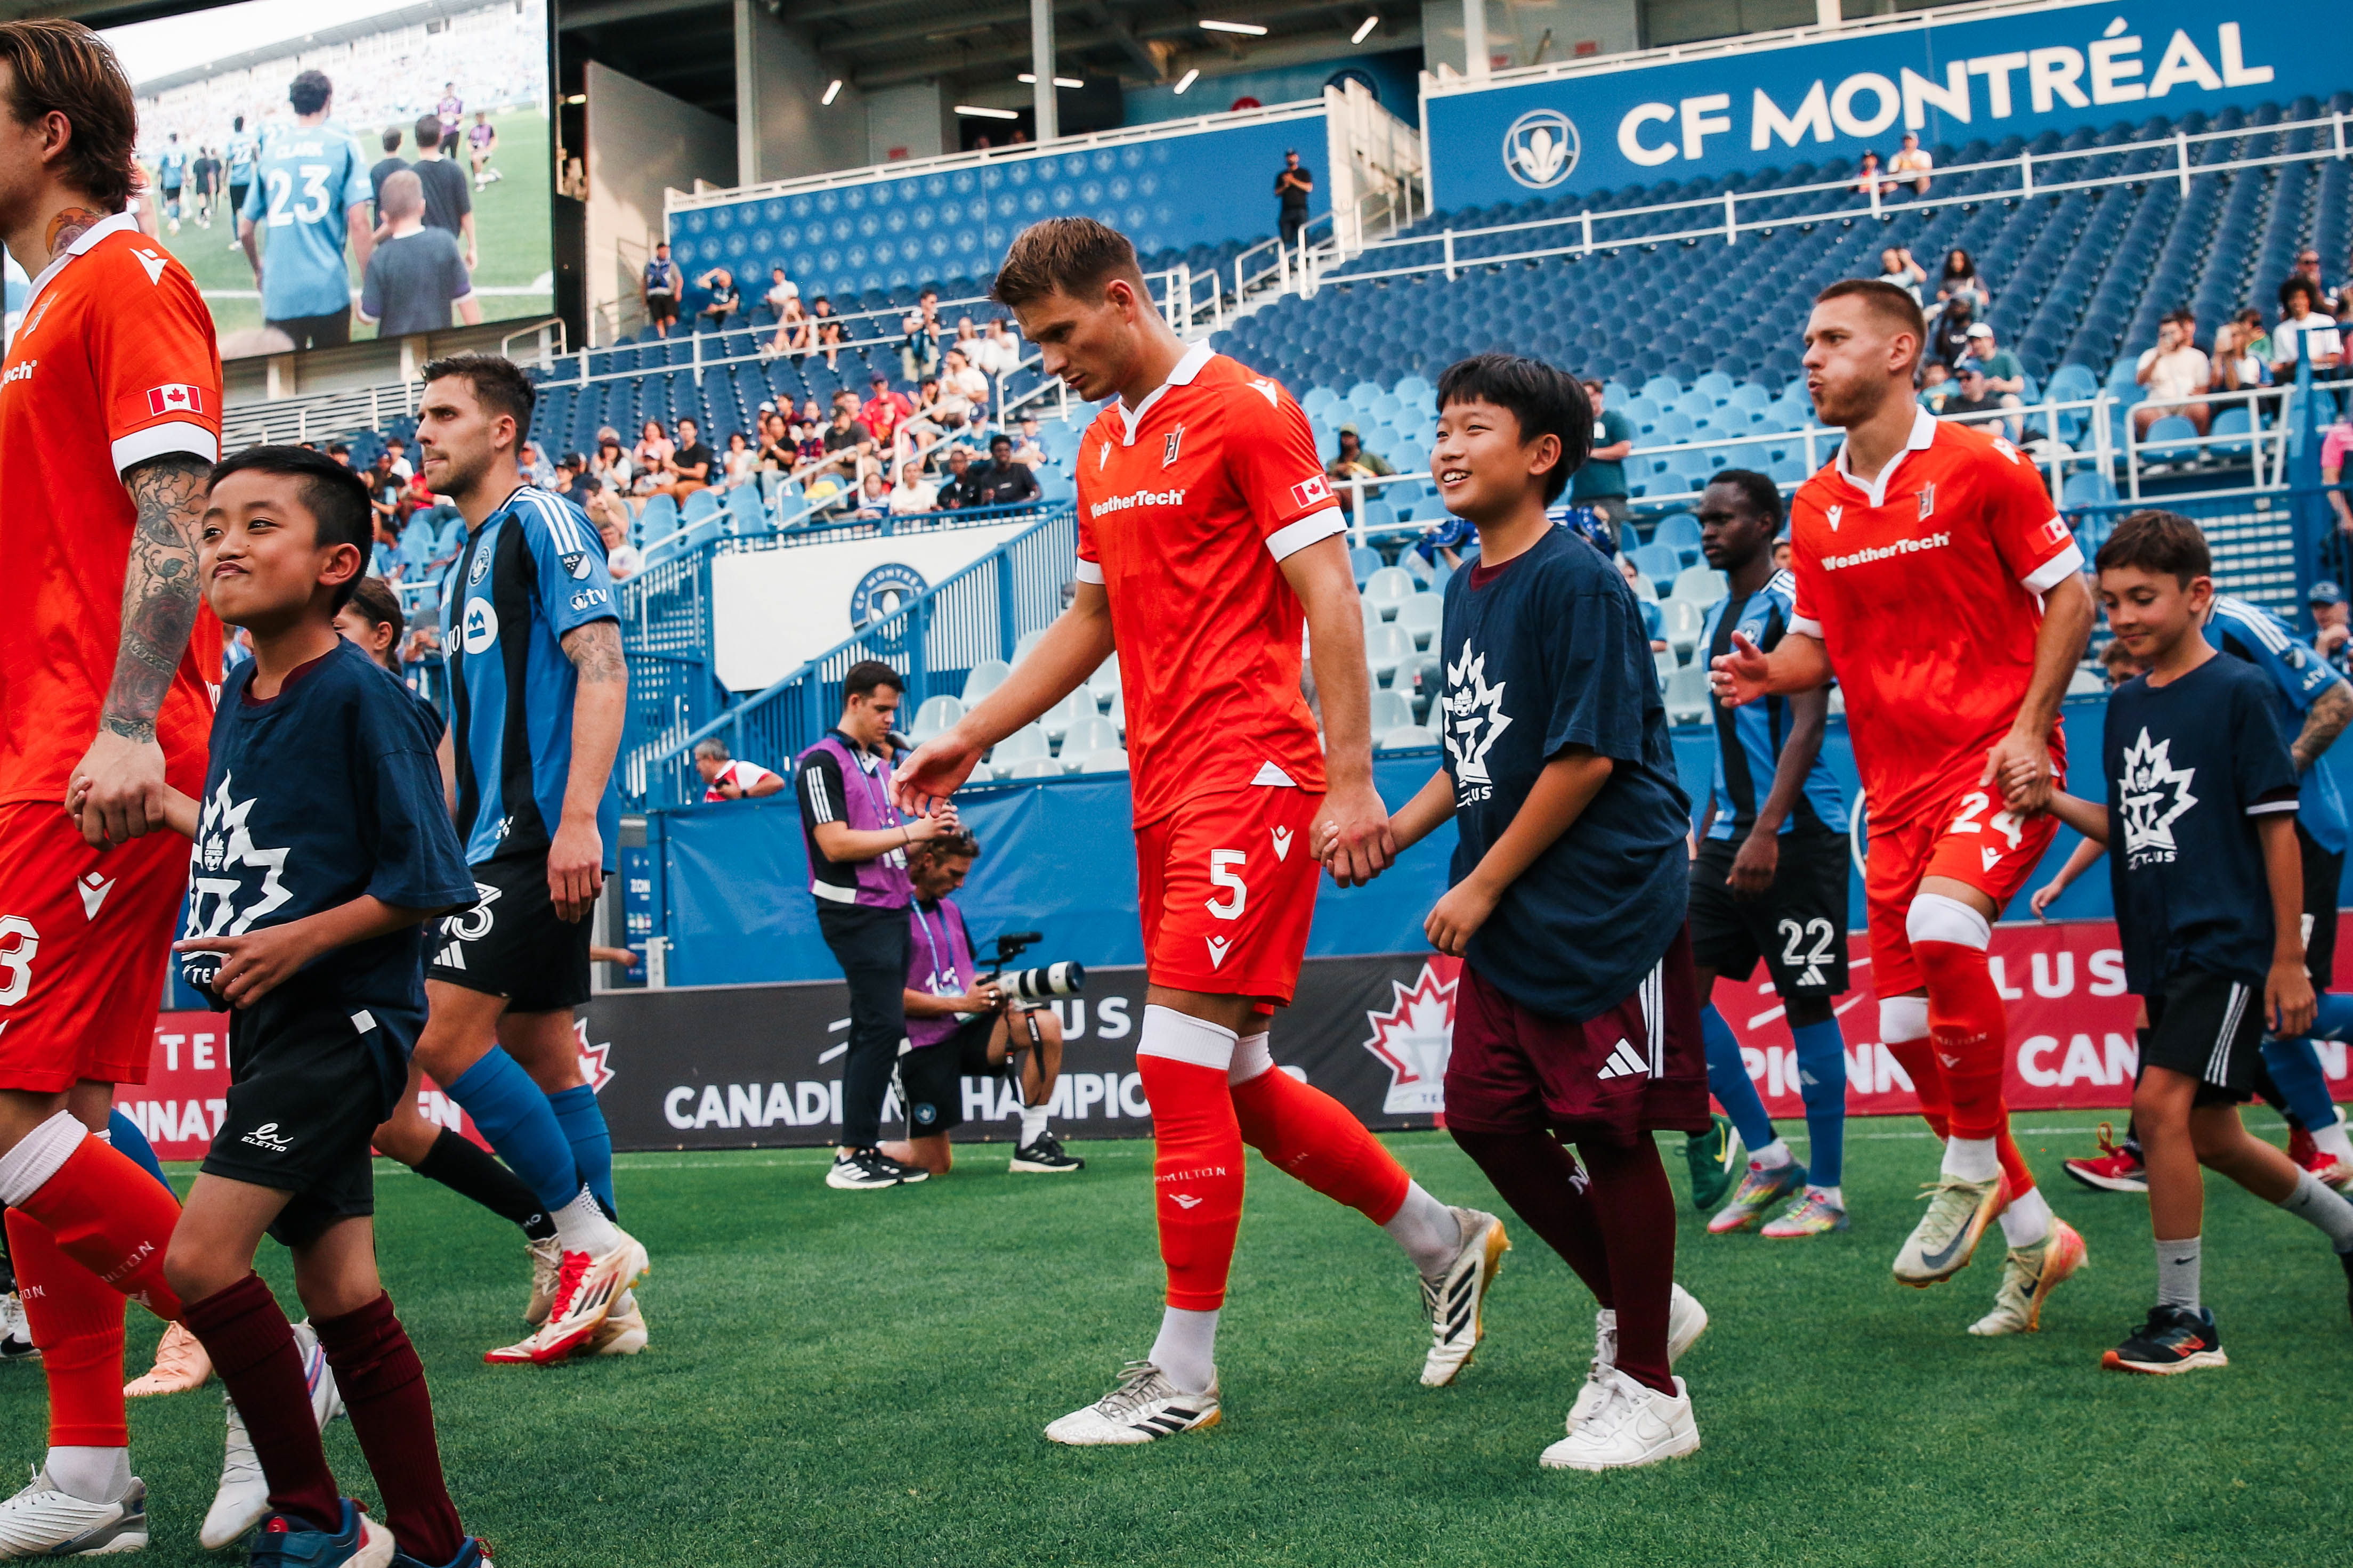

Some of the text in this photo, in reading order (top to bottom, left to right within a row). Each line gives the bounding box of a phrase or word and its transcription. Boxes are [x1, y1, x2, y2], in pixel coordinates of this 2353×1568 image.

[1617, 16, 2275, 167] CF MONTRÉAL
[268, 164, 331, 228] 23
[0, 359, 33, 393] ech
[563, 555, 580, 564] MLS
[1821, 533, 1950, 571] WeatherTech
[585, 588, 608, 605] tv
[1950, 791, 2025, 850] 24
[1204, 849, 1248, 920] 5
[1777, 917, 1835, 965] 22
[159, 1033, 230, 1071] TE
[240, 1136, 287, 1152] ELETTO
